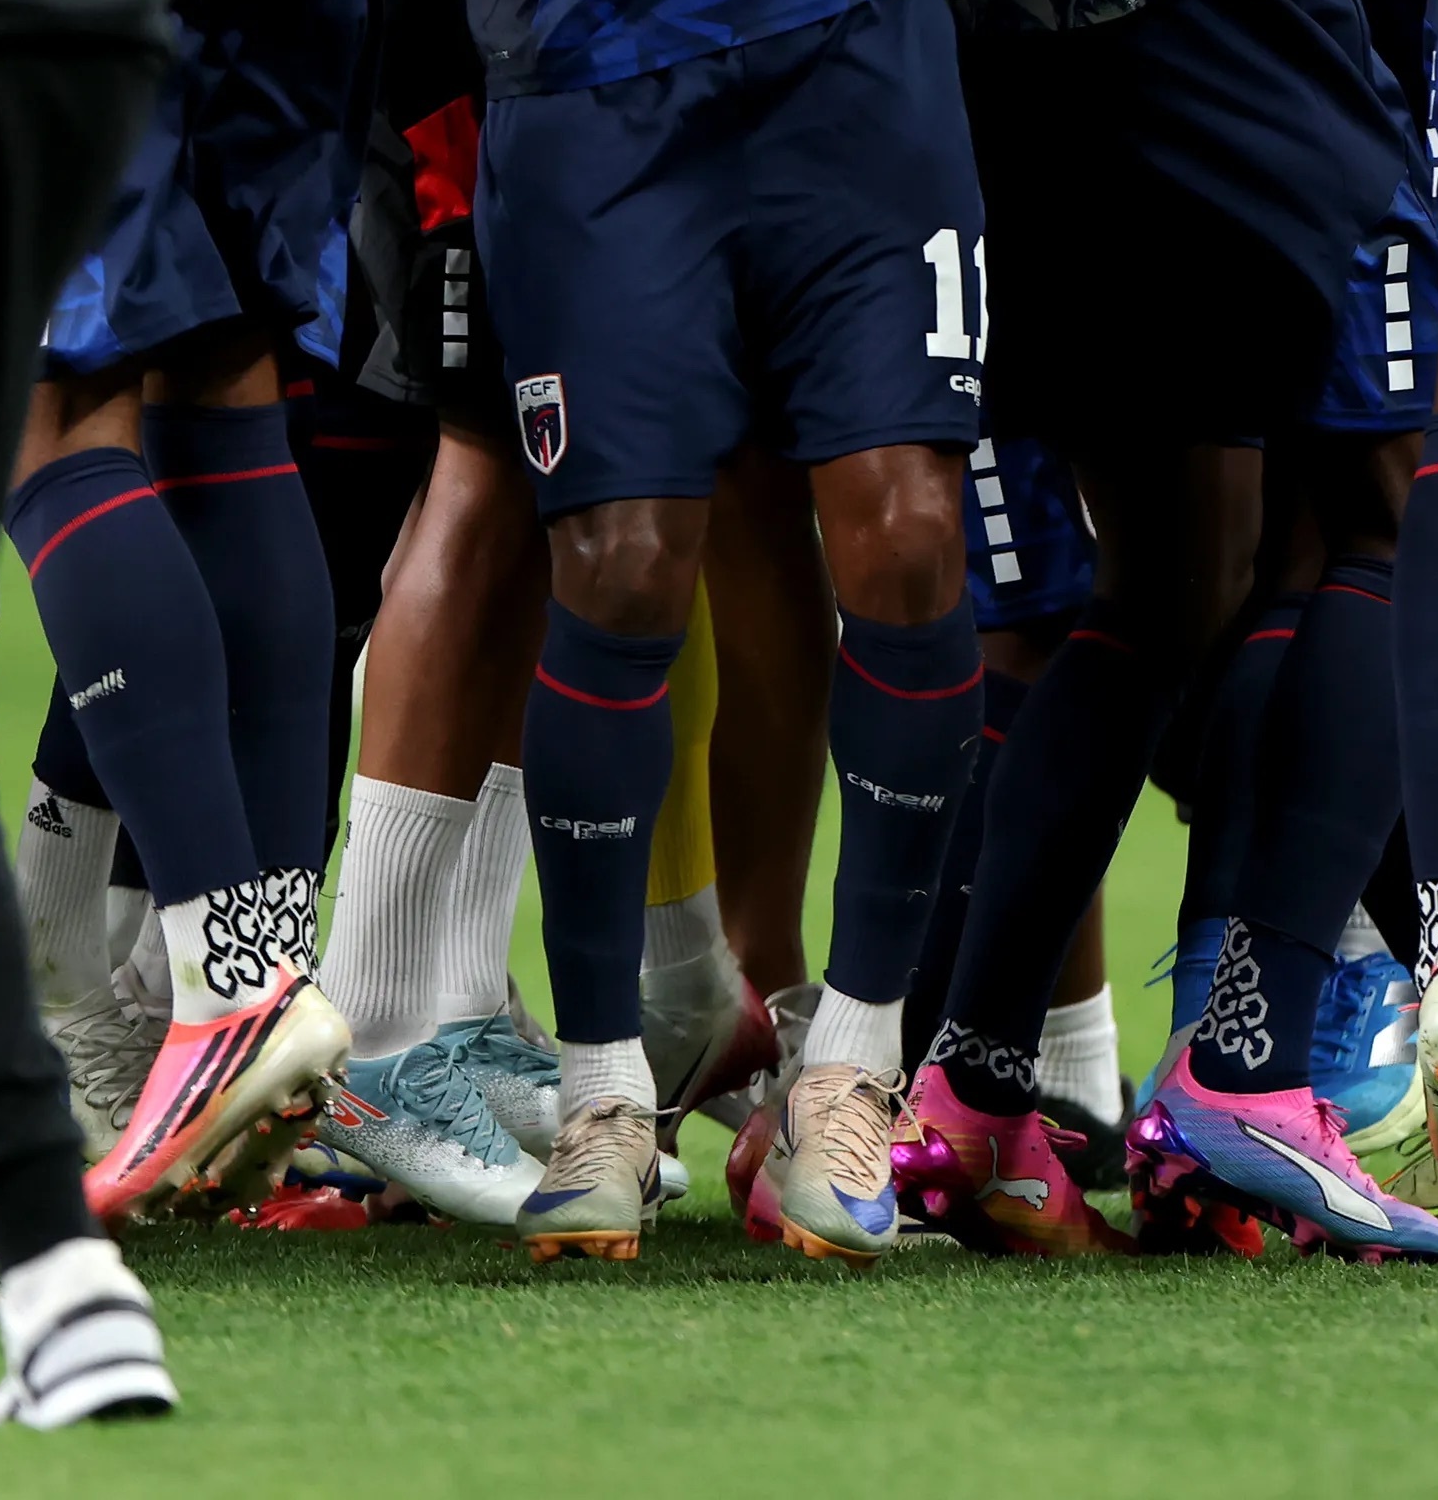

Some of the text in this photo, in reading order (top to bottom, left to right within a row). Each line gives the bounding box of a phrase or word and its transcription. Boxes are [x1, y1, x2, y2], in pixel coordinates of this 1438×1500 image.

[519, 380, 556, 401] FCF
[847, 772, 945, 808] capelli
[28, 810, 72, 838] adidas
[540, 815, 636, 839] capelli
